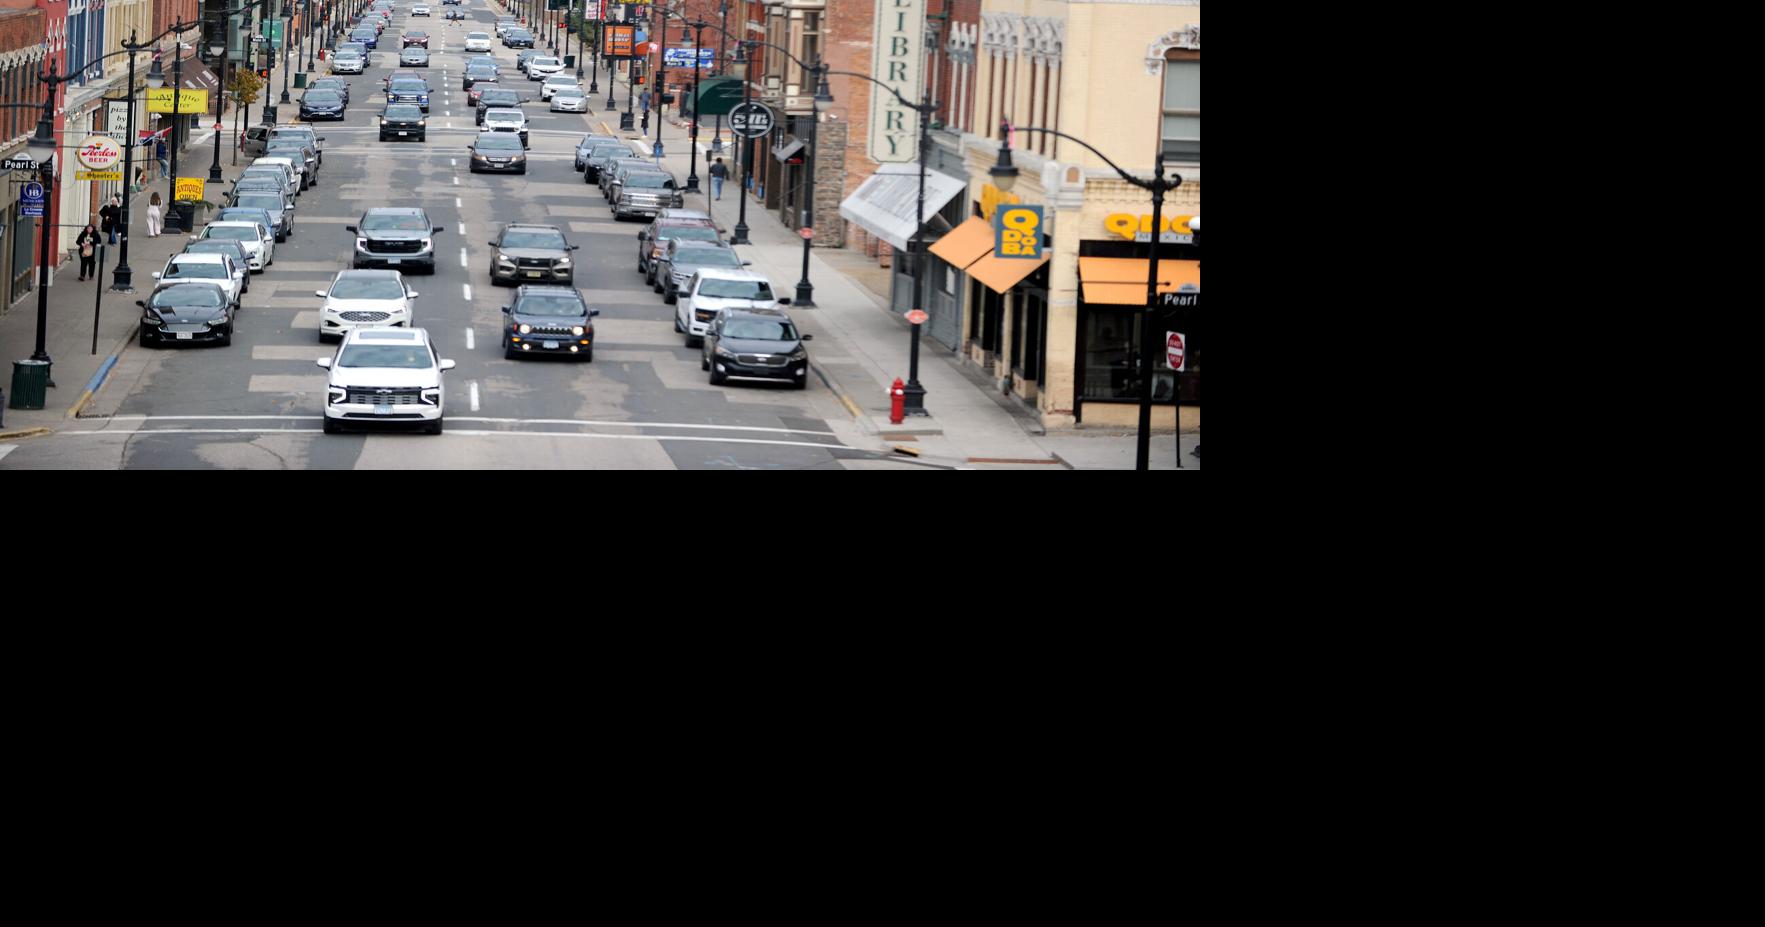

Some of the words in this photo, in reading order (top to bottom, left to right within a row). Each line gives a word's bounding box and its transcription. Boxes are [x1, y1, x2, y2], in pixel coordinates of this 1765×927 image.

[5, 160, 28, 169] Pearl
[30, 160, 39, 169] St
[176, 184, 202, 195] ANTIQUES
[1164, 293, 1198, 306] Pearl
